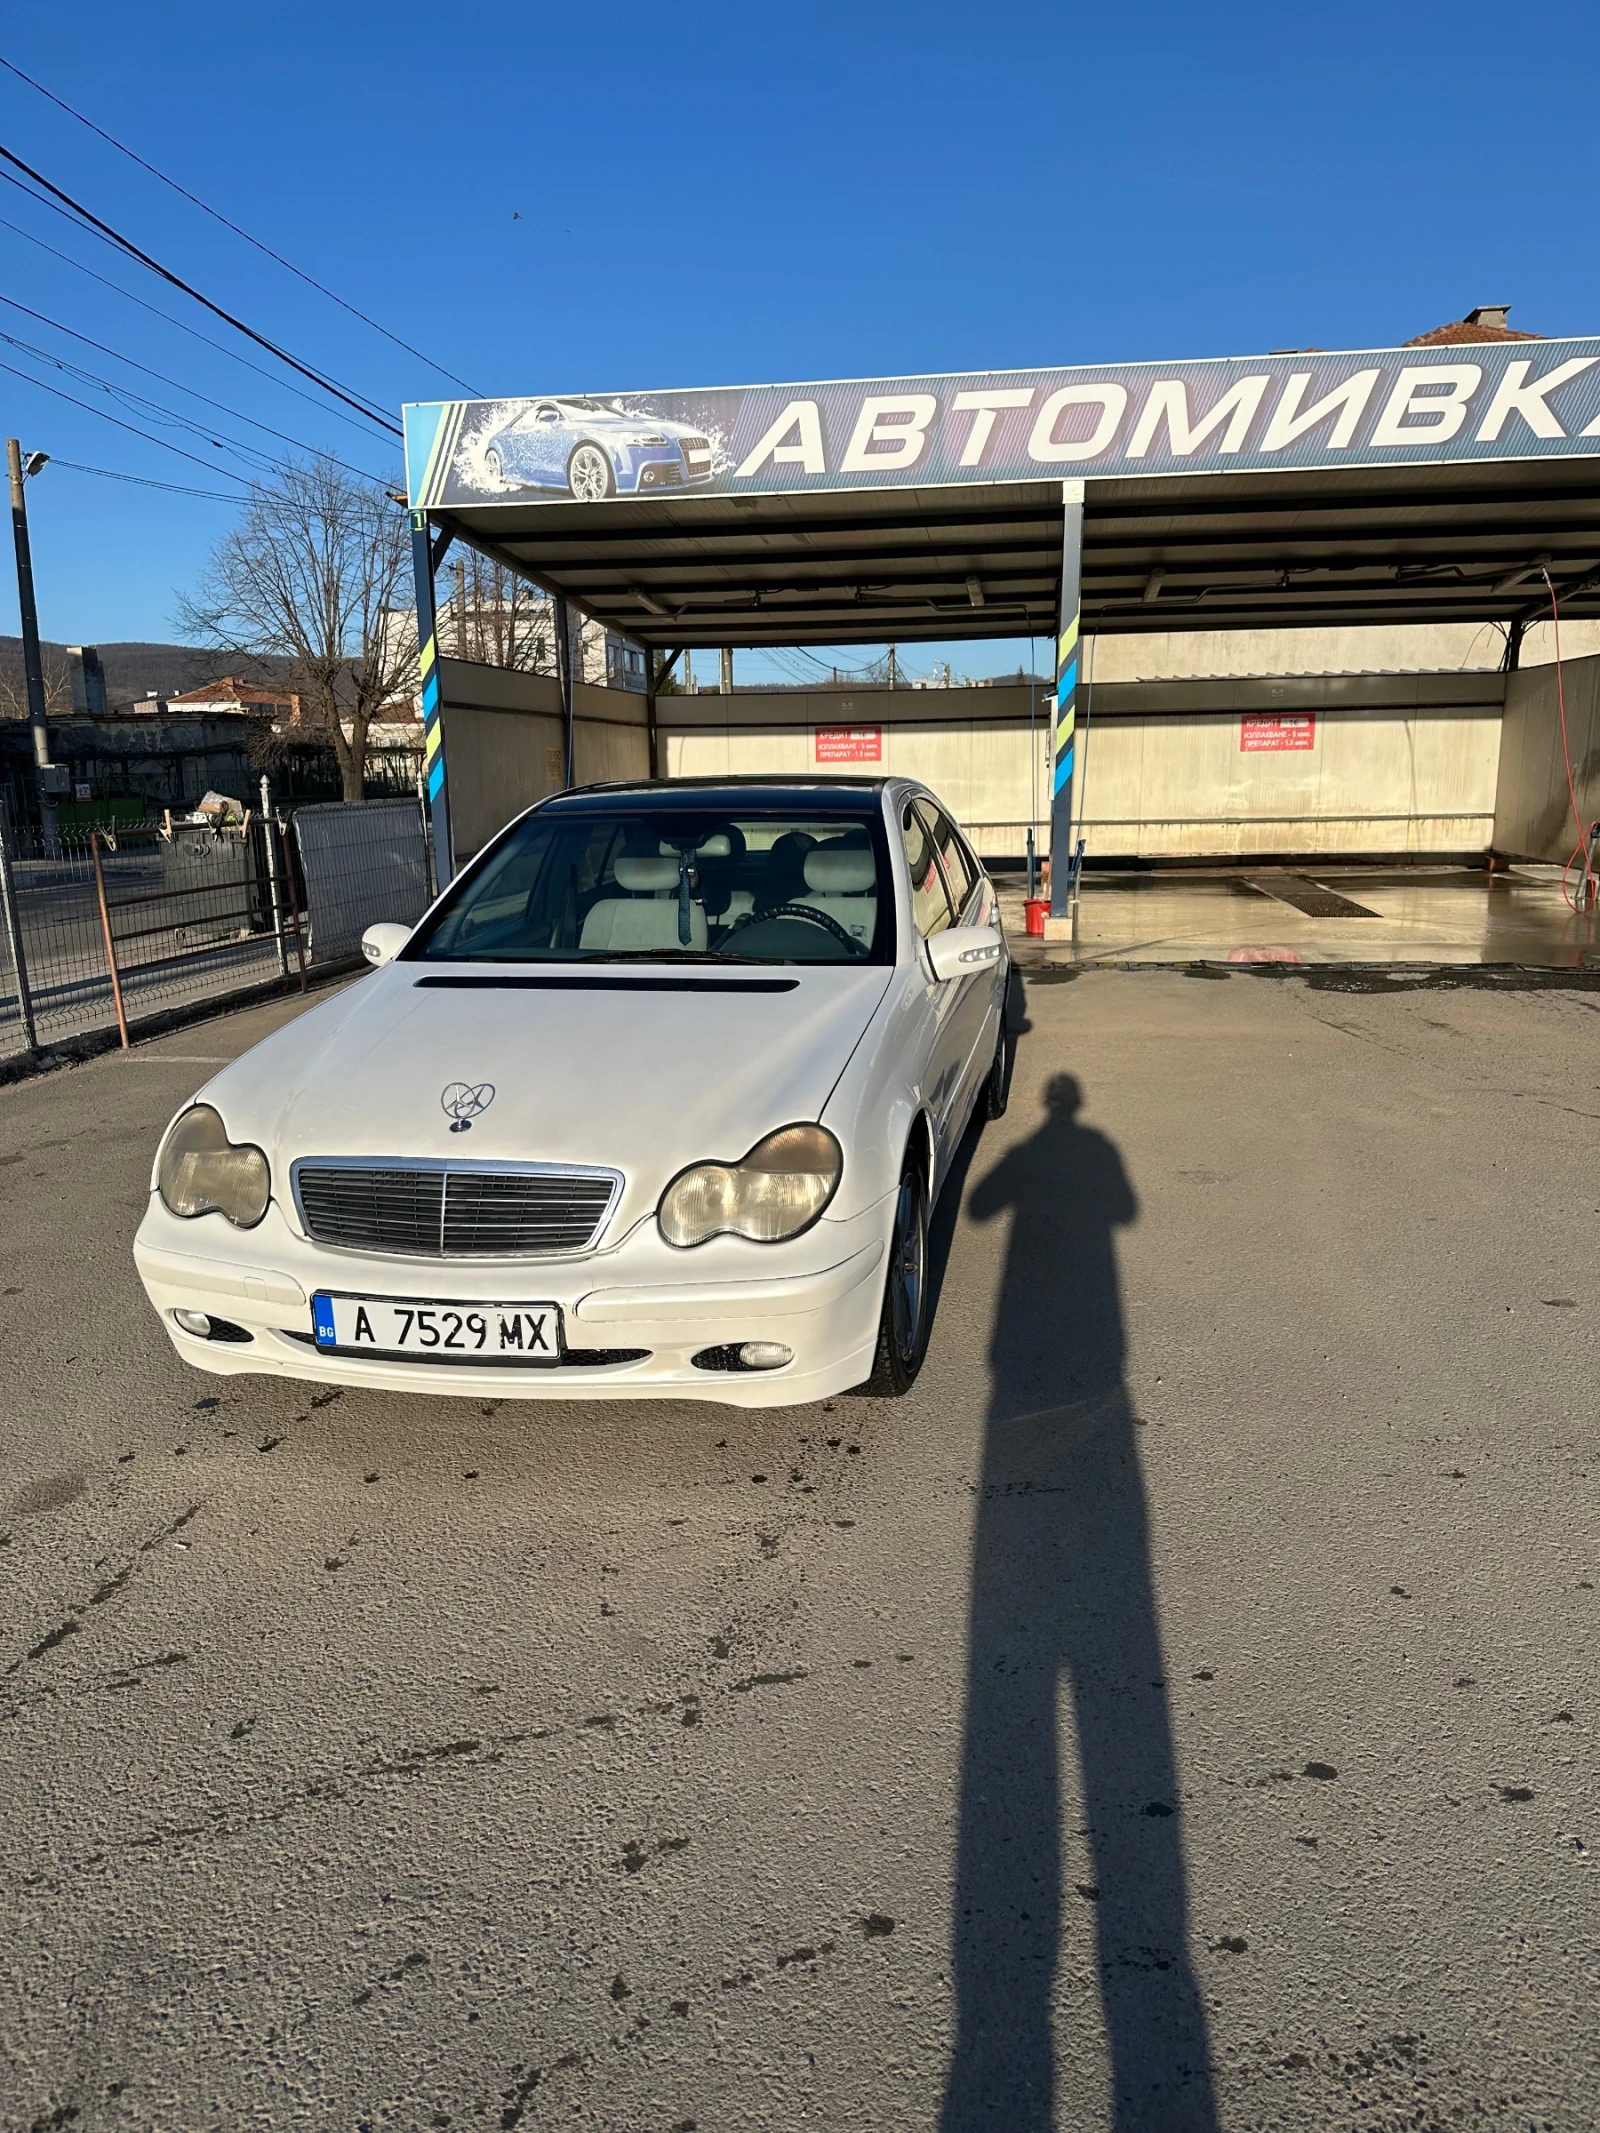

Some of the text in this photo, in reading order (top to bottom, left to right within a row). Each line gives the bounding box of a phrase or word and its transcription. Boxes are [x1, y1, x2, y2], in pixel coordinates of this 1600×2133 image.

[414, 513, 422, 528] 1
[1246, 718, 1278, 728] КРЕДИТ
[819, 731, 848, 740] КРЕДИТ
[1244, 731, 1287, 739] ИЗПЛАКВАНЕ
[319, 1325, 335, 1338] BG
[354, 1306, 550, 1350] A 7529 MX
